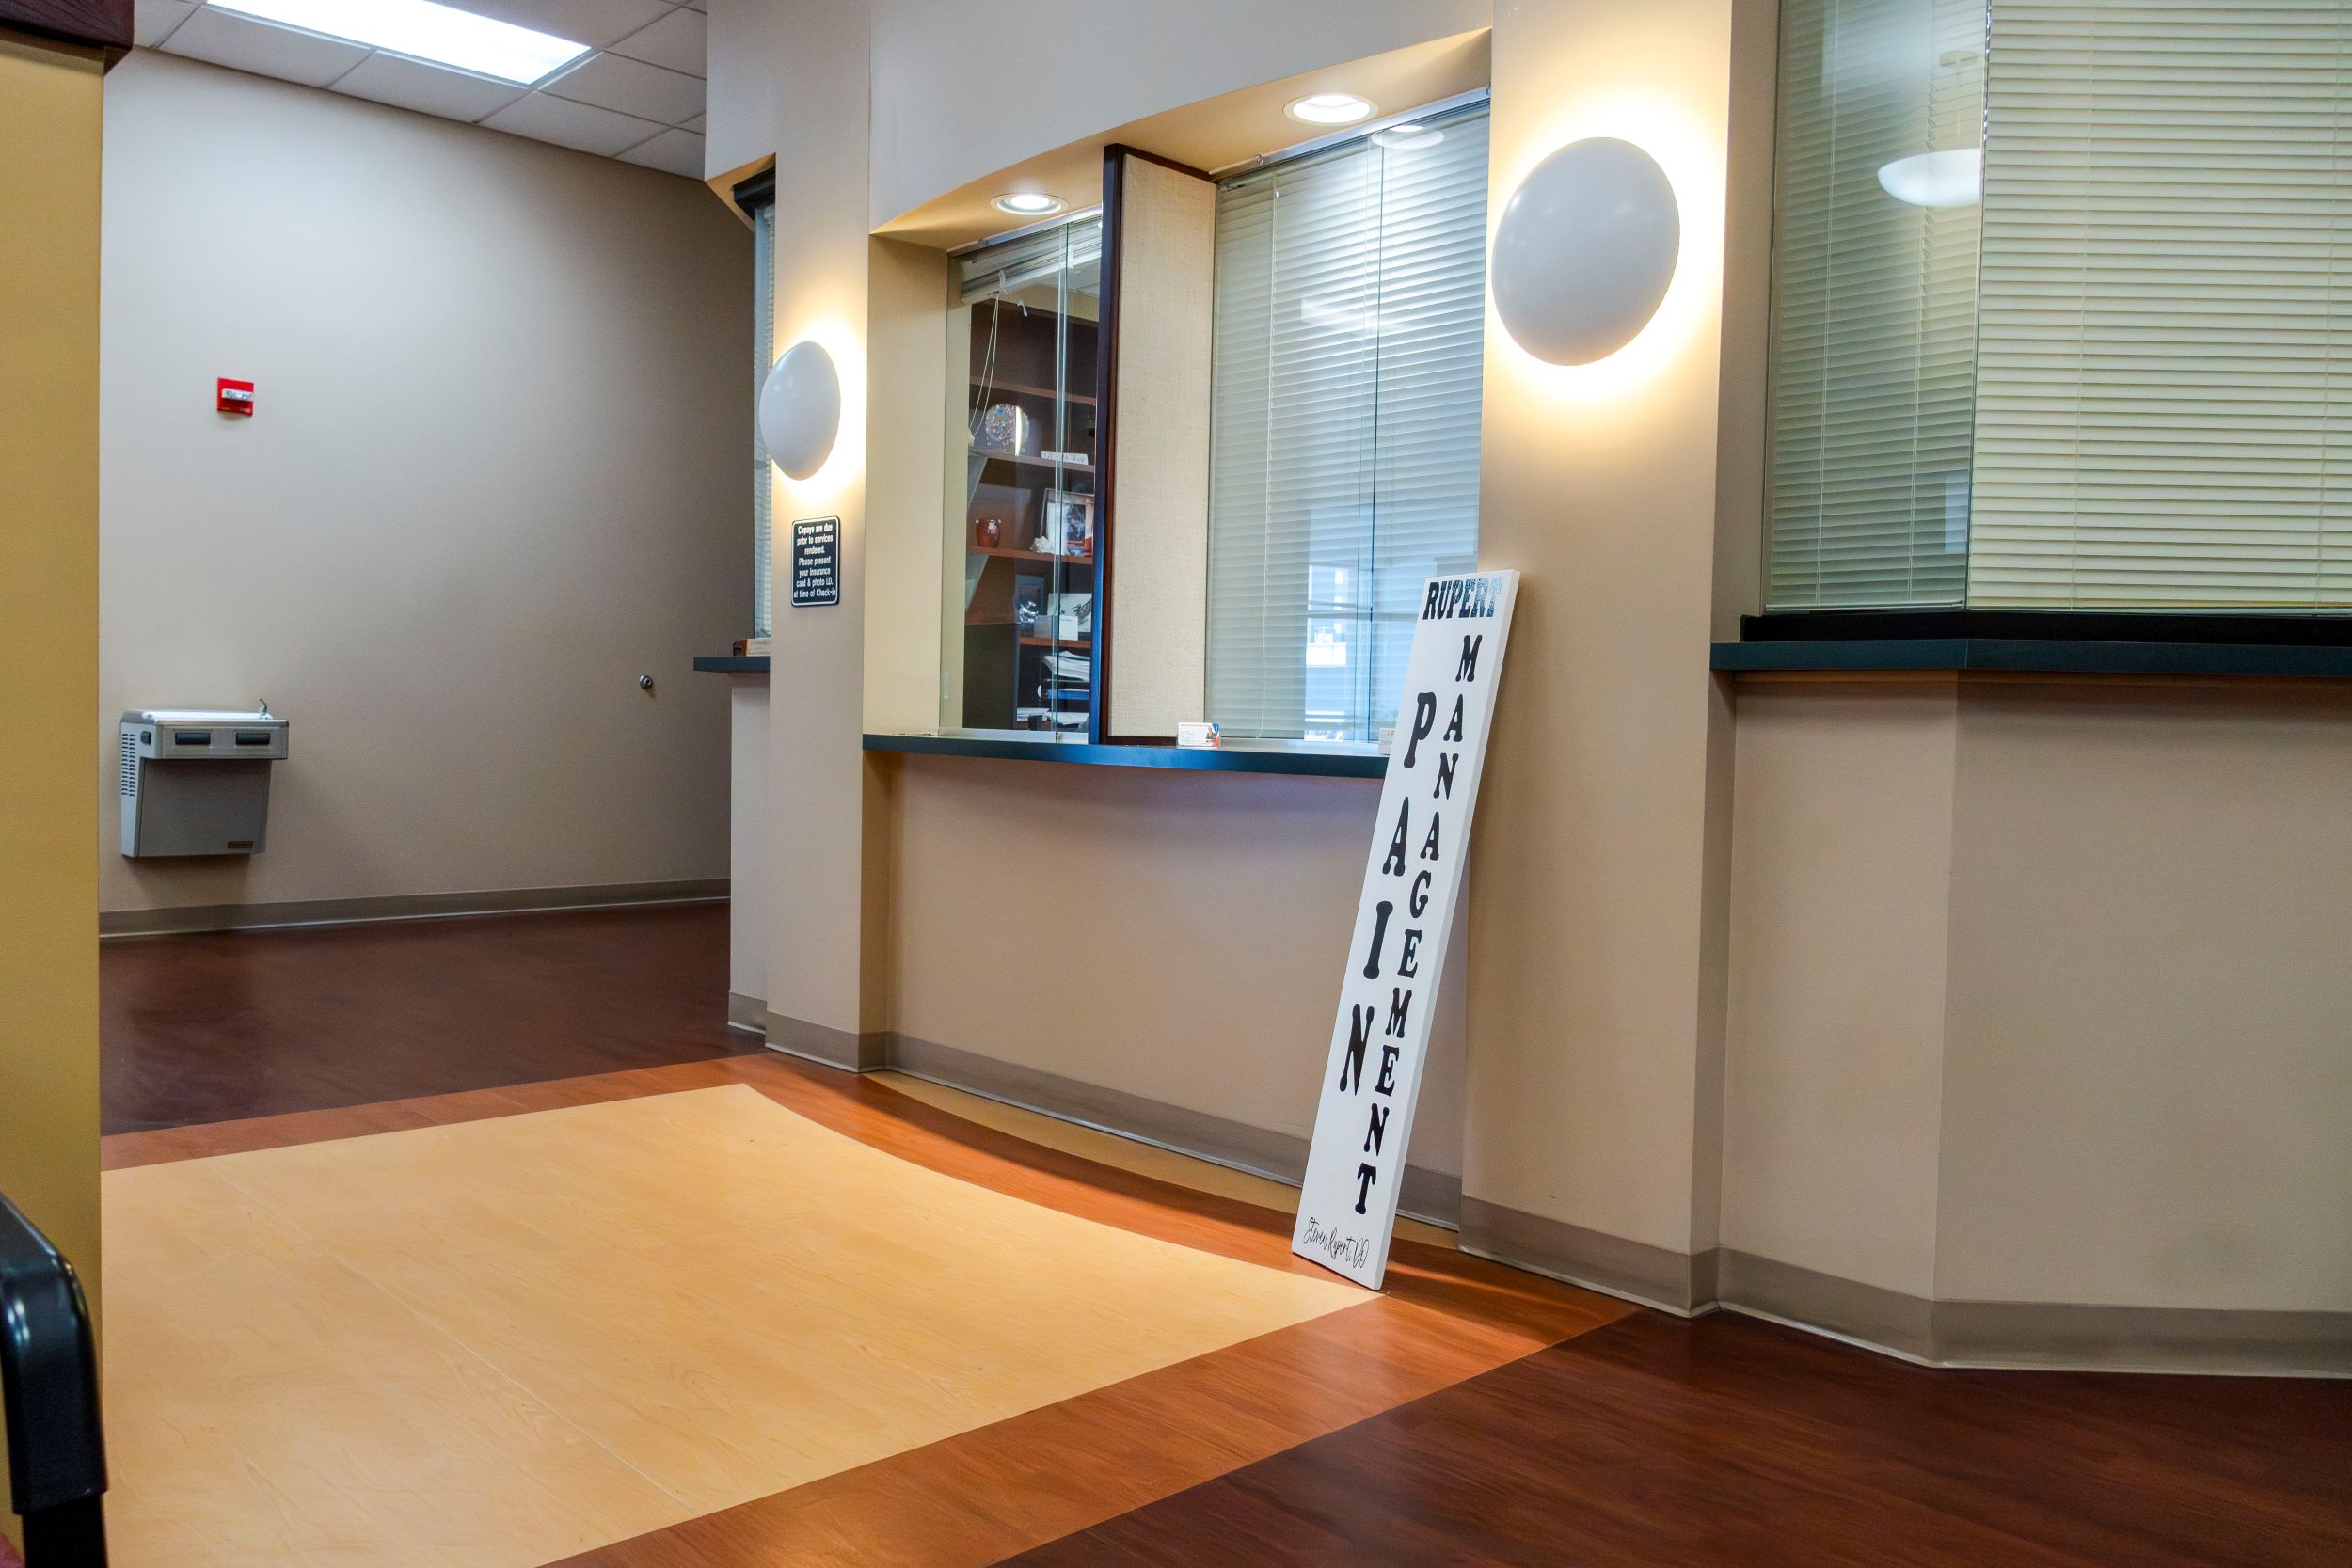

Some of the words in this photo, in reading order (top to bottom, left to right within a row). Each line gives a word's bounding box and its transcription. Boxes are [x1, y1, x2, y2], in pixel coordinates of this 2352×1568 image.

[797, 525, 815, 535] Copays
[815, 524, 823, 532] are
[824, 523, 833, 531] due
[797, 536, 807, 546] prior
[808, 535, 814, 544] to
[815, 534, 834, 544] services
[798, 557, 813, 566] Please
[814, 556, 832, 566] present
[799, 568, 809, 578] your
[809, 567, 831, 576] insurance
[796, 578, 806, 588] card
[807, 578, 811, 587] &
[812, 578, 825, 588] photo
[793, 590, 799, 598] at
[799, 589, 809, 598] time
[809, 588, 816, 597] of
[816, 587, 836, 597] Check-in
[1422, 577, 1504, 621] RUPERT
[1339, 691, 1437, 1097] PAIN
[1354, 634, 1483, 1215] MANAGEMENT
[1303, 1217, 1327, 1251] Steven
